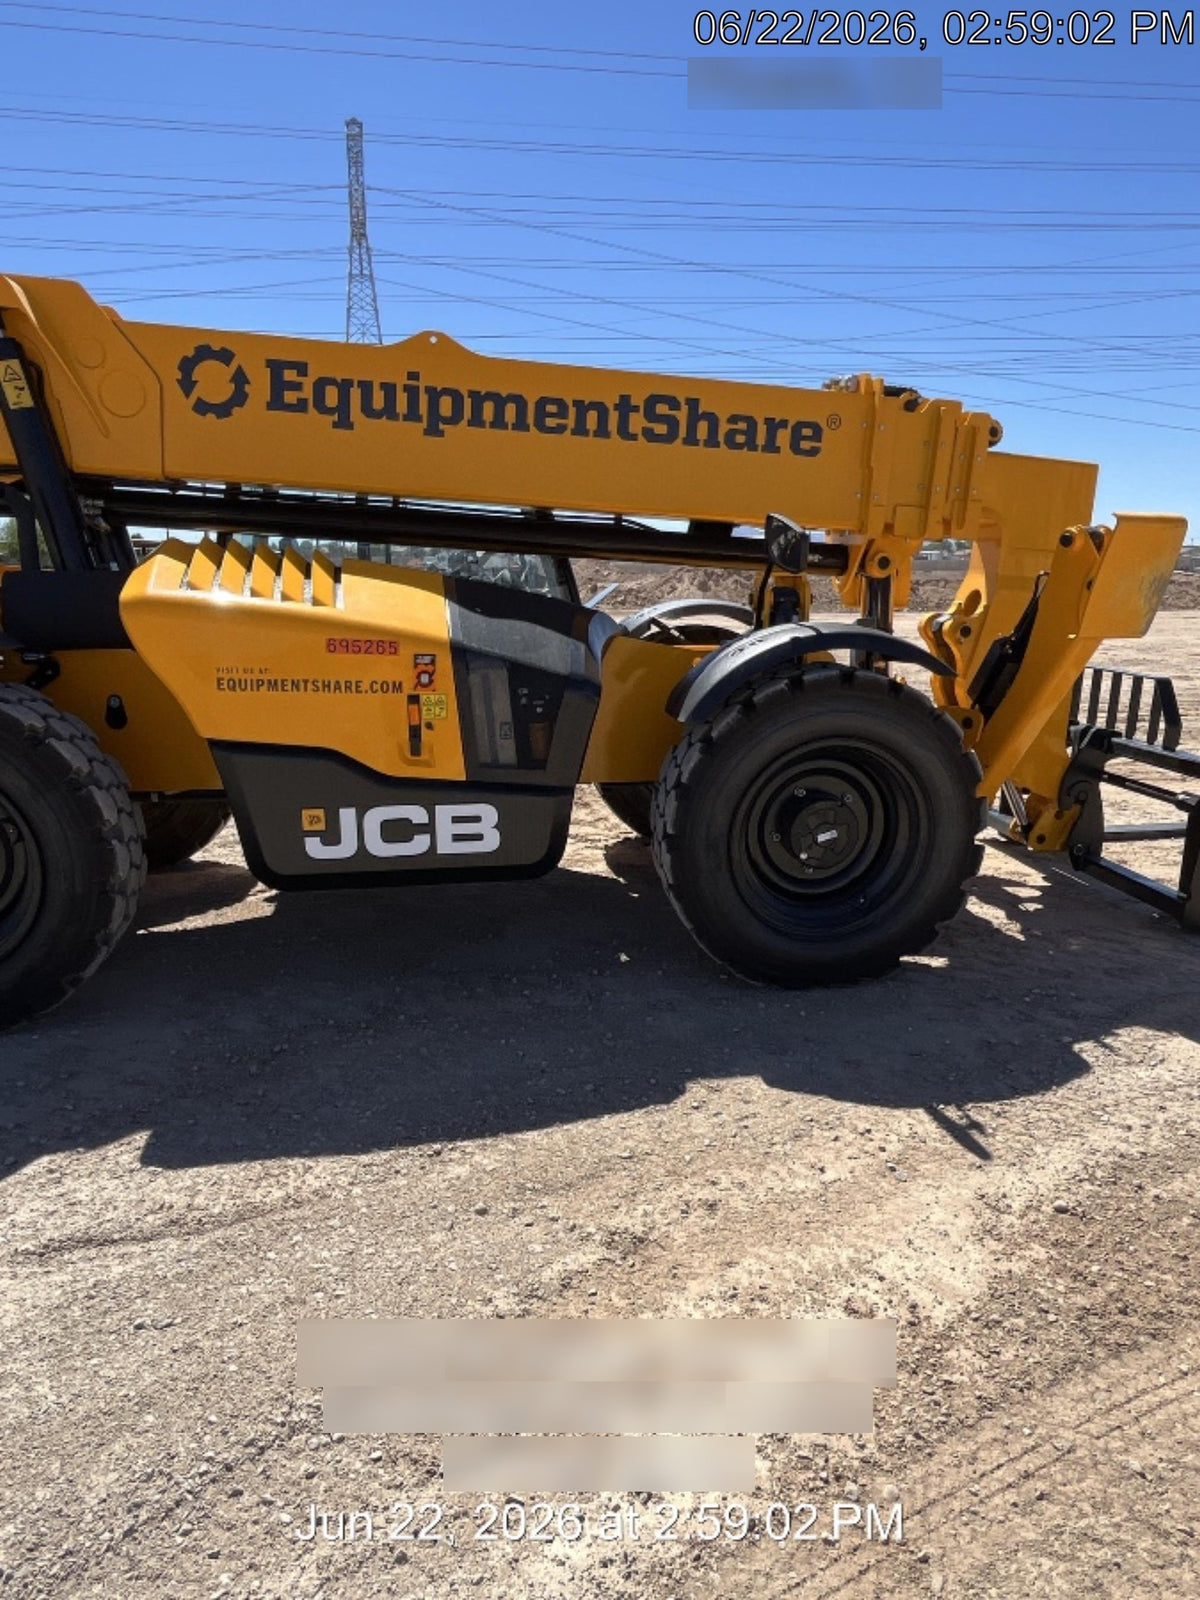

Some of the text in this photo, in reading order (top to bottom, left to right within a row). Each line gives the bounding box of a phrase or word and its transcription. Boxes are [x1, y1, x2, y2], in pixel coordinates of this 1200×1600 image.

[327, 637, 399, 655] 695265
[216, 677, 404, 694] EQUIPMENTSHARE.COM
[303, 802, 501, 859] JCB
